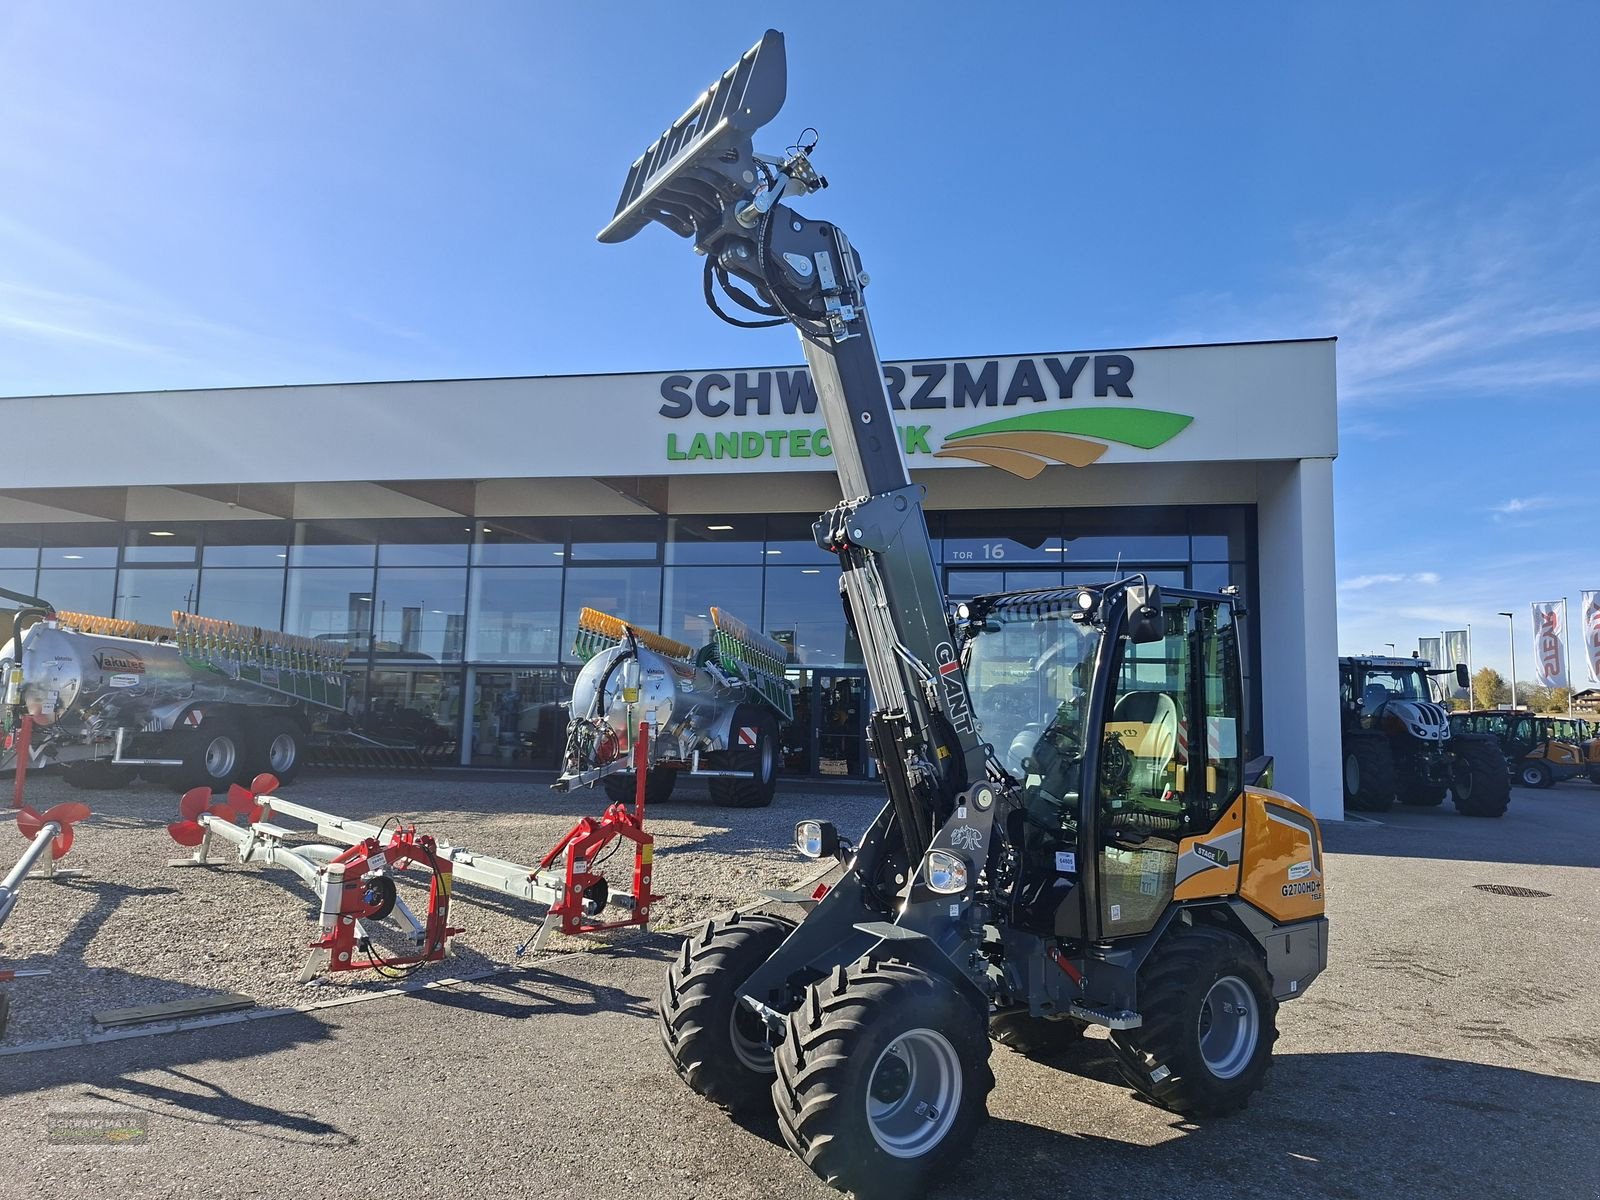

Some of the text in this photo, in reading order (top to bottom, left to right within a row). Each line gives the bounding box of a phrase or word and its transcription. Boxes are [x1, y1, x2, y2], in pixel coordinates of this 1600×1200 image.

[658, 354, 1135, 419] SCHWRZMAYR
[666, 425, 932, 460] LANDTECK
[952, 543, 1005, 560] TOR 16
[92, 652, 145, 670] Vakutec
[934, 641, 975, 735] GIANT
[1197, 847, 1216, 861] STAGE
[1281, 880, 1321, 897] G2700HD+
